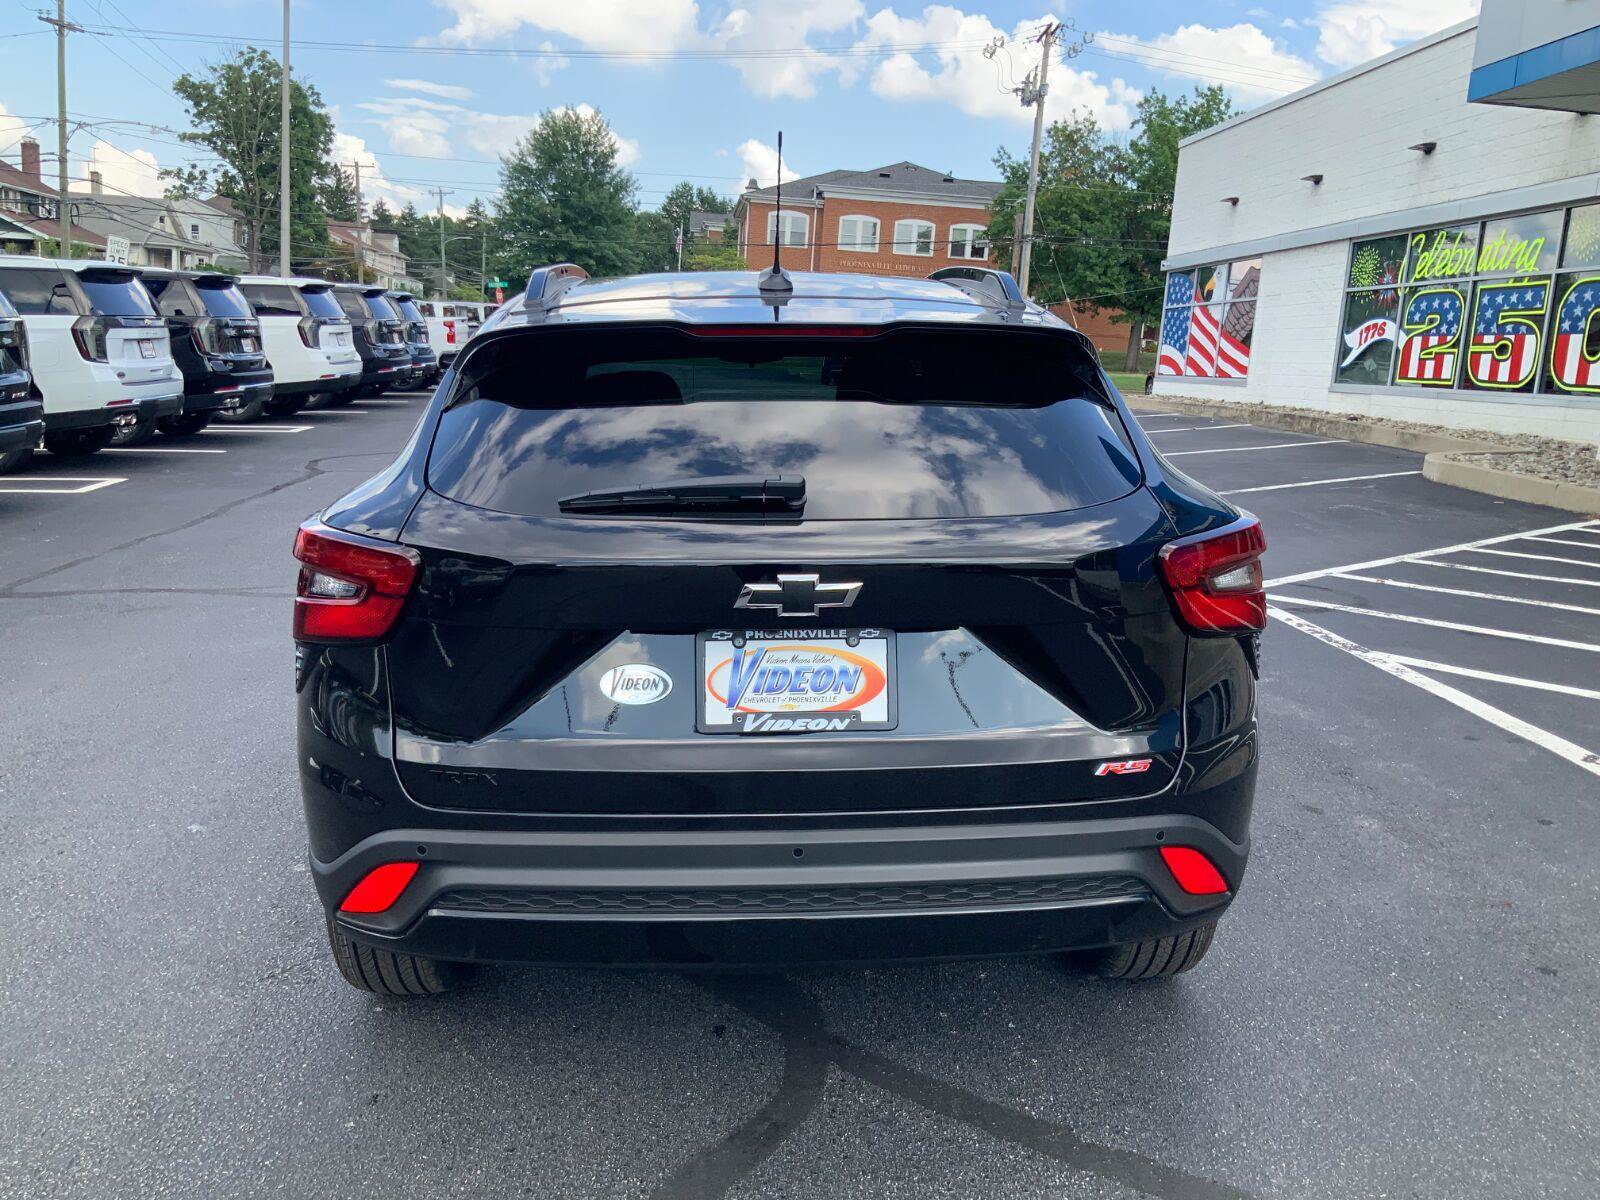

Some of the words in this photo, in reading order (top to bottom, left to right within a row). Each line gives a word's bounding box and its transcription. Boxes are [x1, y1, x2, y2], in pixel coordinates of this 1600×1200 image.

[109, 239, 129, 249] SPEED
[110, 247, 126, 256] LIMIT
[1398, 228, 1545, 297] Celebrating
[1357, 321, 1387, 349] 1776
[745, 629, 847, 640] PHOENIXVILLE
[610, 668, 662, 697] VIDEON
[726, 647, 863, 711] VIDEON
[744, 695, 781, 704] CHEVROLET
[788, 695, 837, 703] PHOENIXVILLE
[742, 713, 851, 732] VIDEON
[1094, 758, 1152, 776] RS
[428, 769, 498, 786] TRAX
